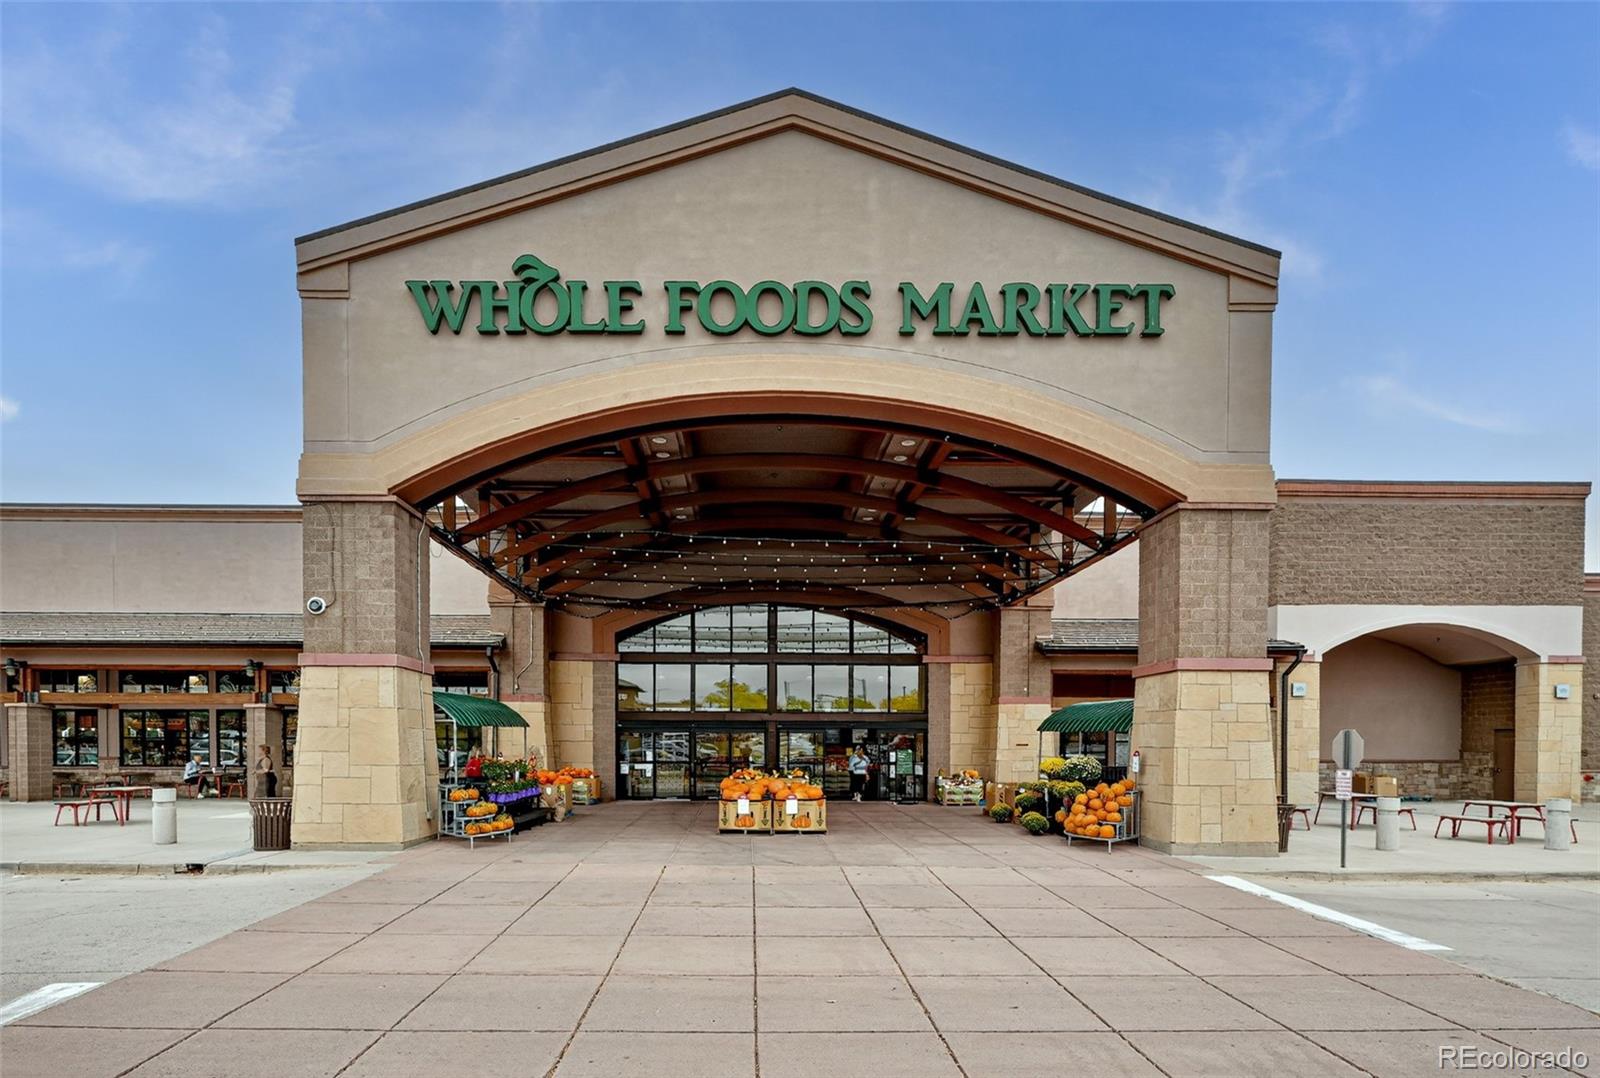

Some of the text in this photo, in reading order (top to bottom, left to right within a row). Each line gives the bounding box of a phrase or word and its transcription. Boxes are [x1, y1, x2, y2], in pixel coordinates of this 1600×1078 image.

[405, 254, 1176, 337] WHOLE FOODS MARKET
